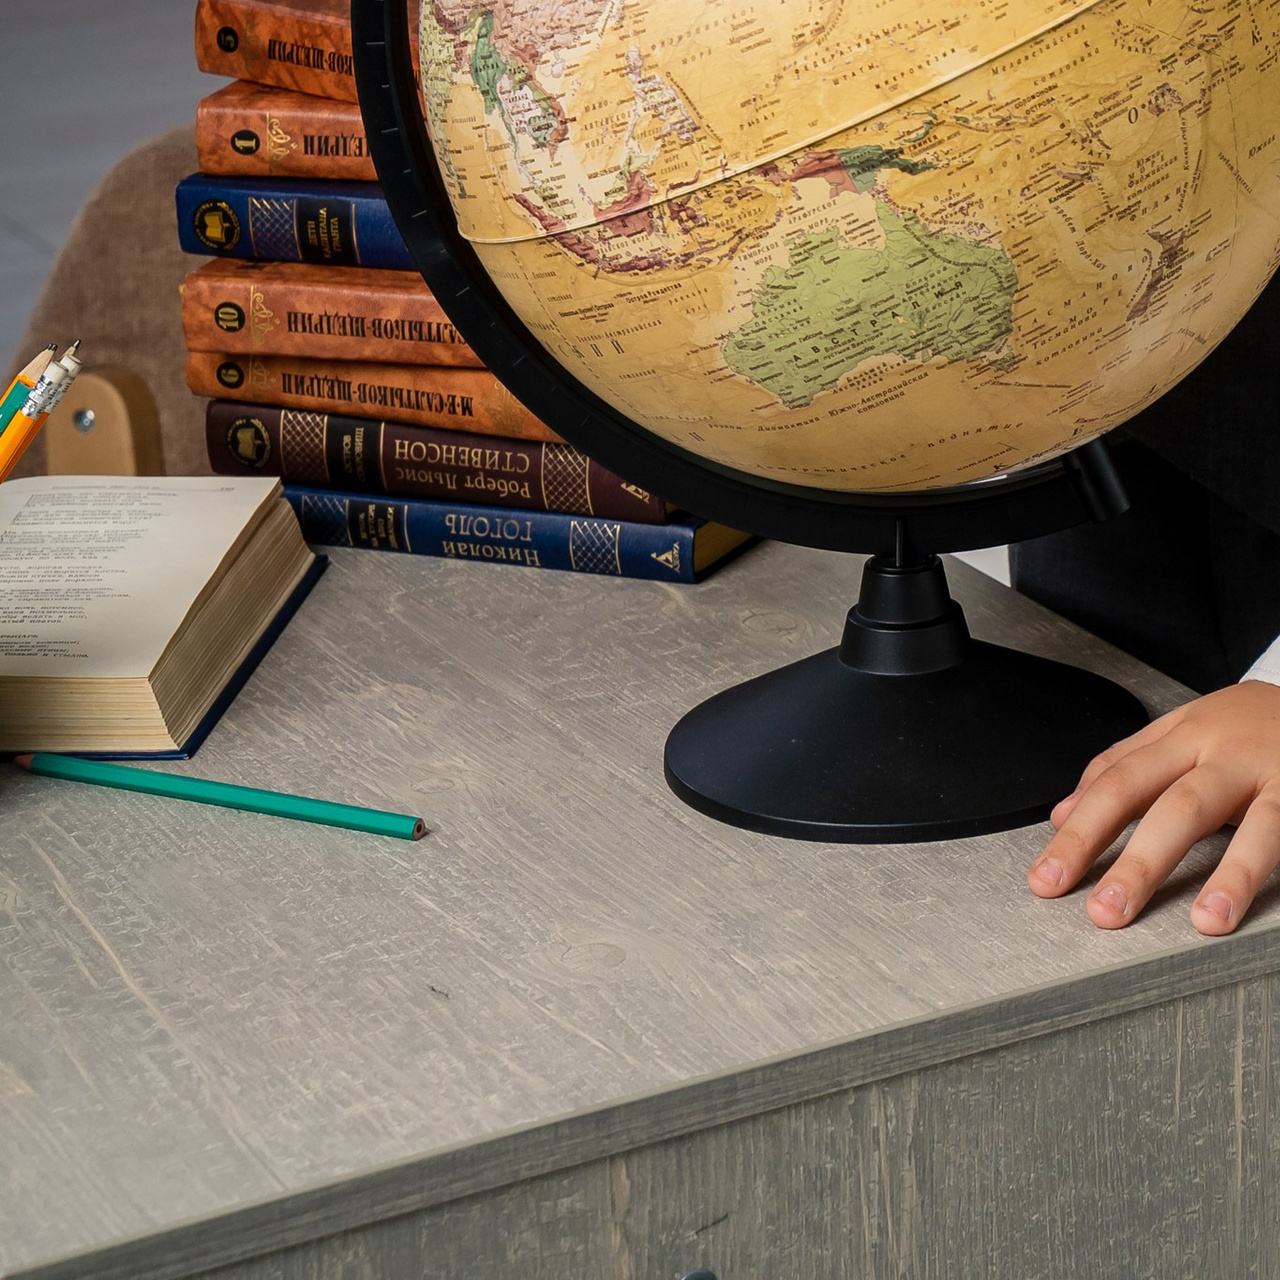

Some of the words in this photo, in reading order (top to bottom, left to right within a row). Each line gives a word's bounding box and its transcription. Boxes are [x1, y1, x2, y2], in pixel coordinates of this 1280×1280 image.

[267, 39, 352, 76] КОВ-ЩЕДРИН
[235, 137, 256, 150] 1
[218, 307, 239, 329] 10
[1035, 326, 1104, 366] котловина
[827, 371, 931, 418] Южно-Австралийская
[856, 390, 907, 415] котловина
[394, 439, 530, 474] СТИВЕНСОН
[394, 466, 458, 489] Льюис
[464, 471, 532, 498] Роберт
[444, 513, 533, 542] ГОГОЛЬ
[440, 540, 541, 567] Николай
